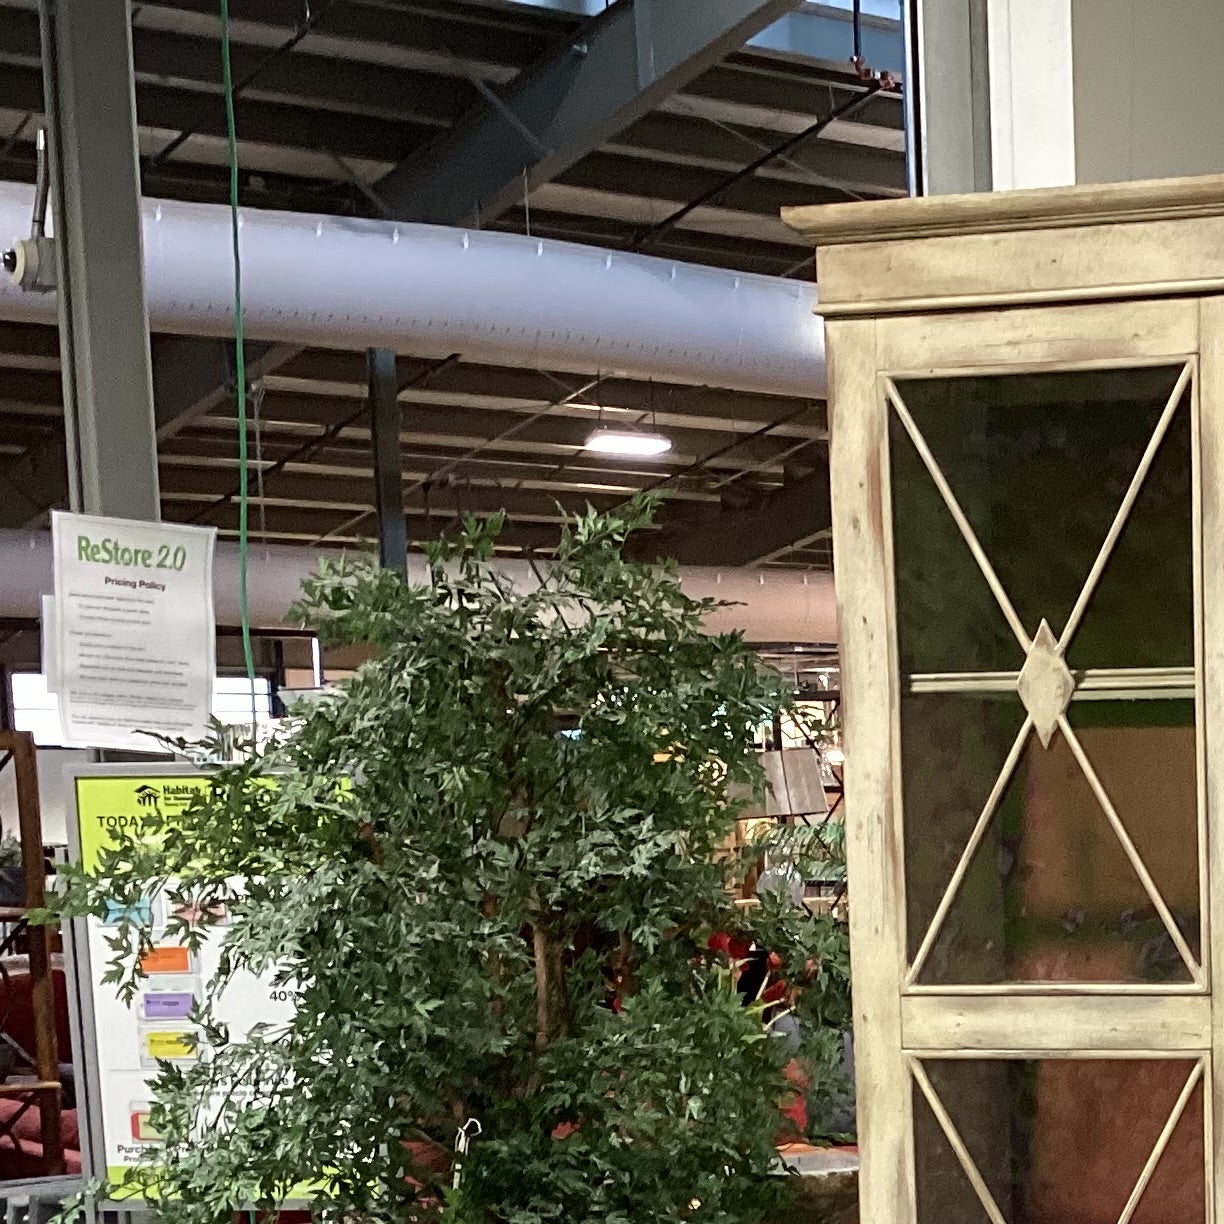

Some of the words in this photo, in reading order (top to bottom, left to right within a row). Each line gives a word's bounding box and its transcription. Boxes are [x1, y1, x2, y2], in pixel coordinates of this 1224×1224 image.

[77, 535, 153, 568] ReStore
[156, 544, 187, 571] 2.0
[104, 576, 137, 589] Pricing
[138, 580, 166, 592] Policy
